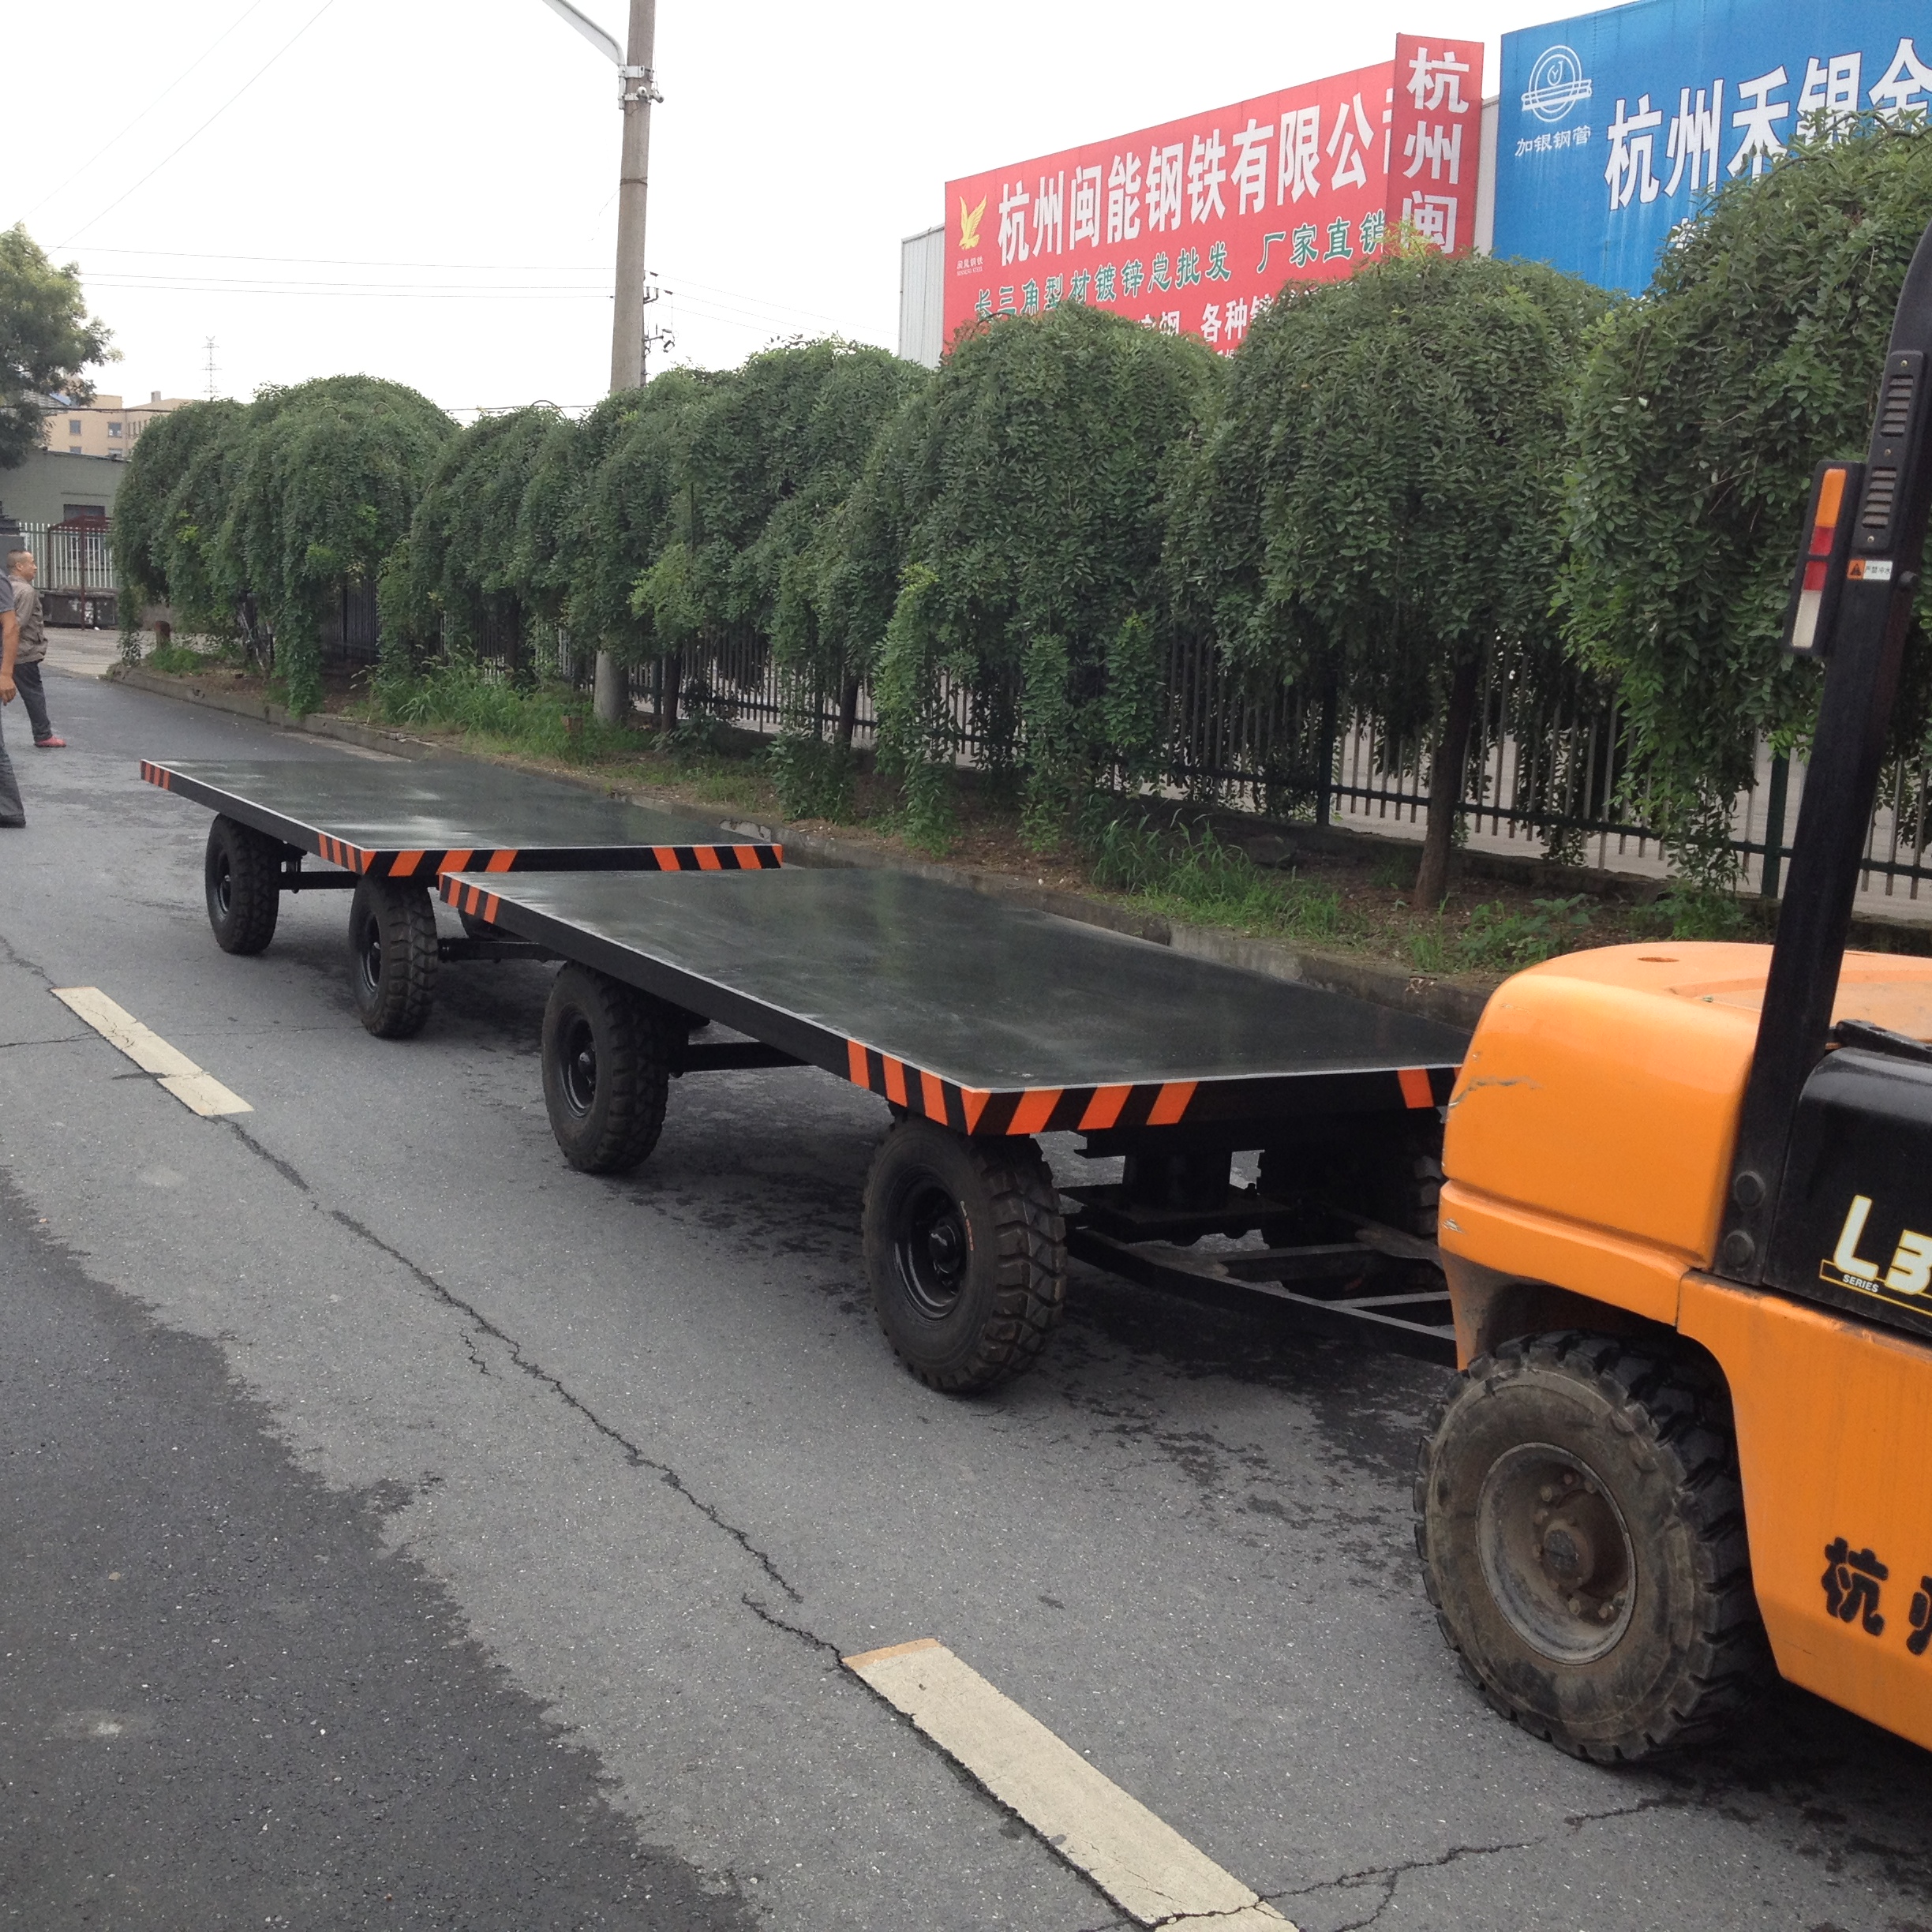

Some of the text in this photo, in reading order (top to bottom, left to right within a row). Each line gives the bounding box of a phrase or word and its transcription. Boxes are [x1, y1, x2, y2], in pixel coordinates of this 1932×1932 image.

[998, 88, 1394, 266] 杭州闽能钢铁有限公
[1402, 47, 1470, 254] 杭州闽
[1515, 125, 1591, 157] 加银钢管
[1842, 1274, 1880, 1294] SERIES
